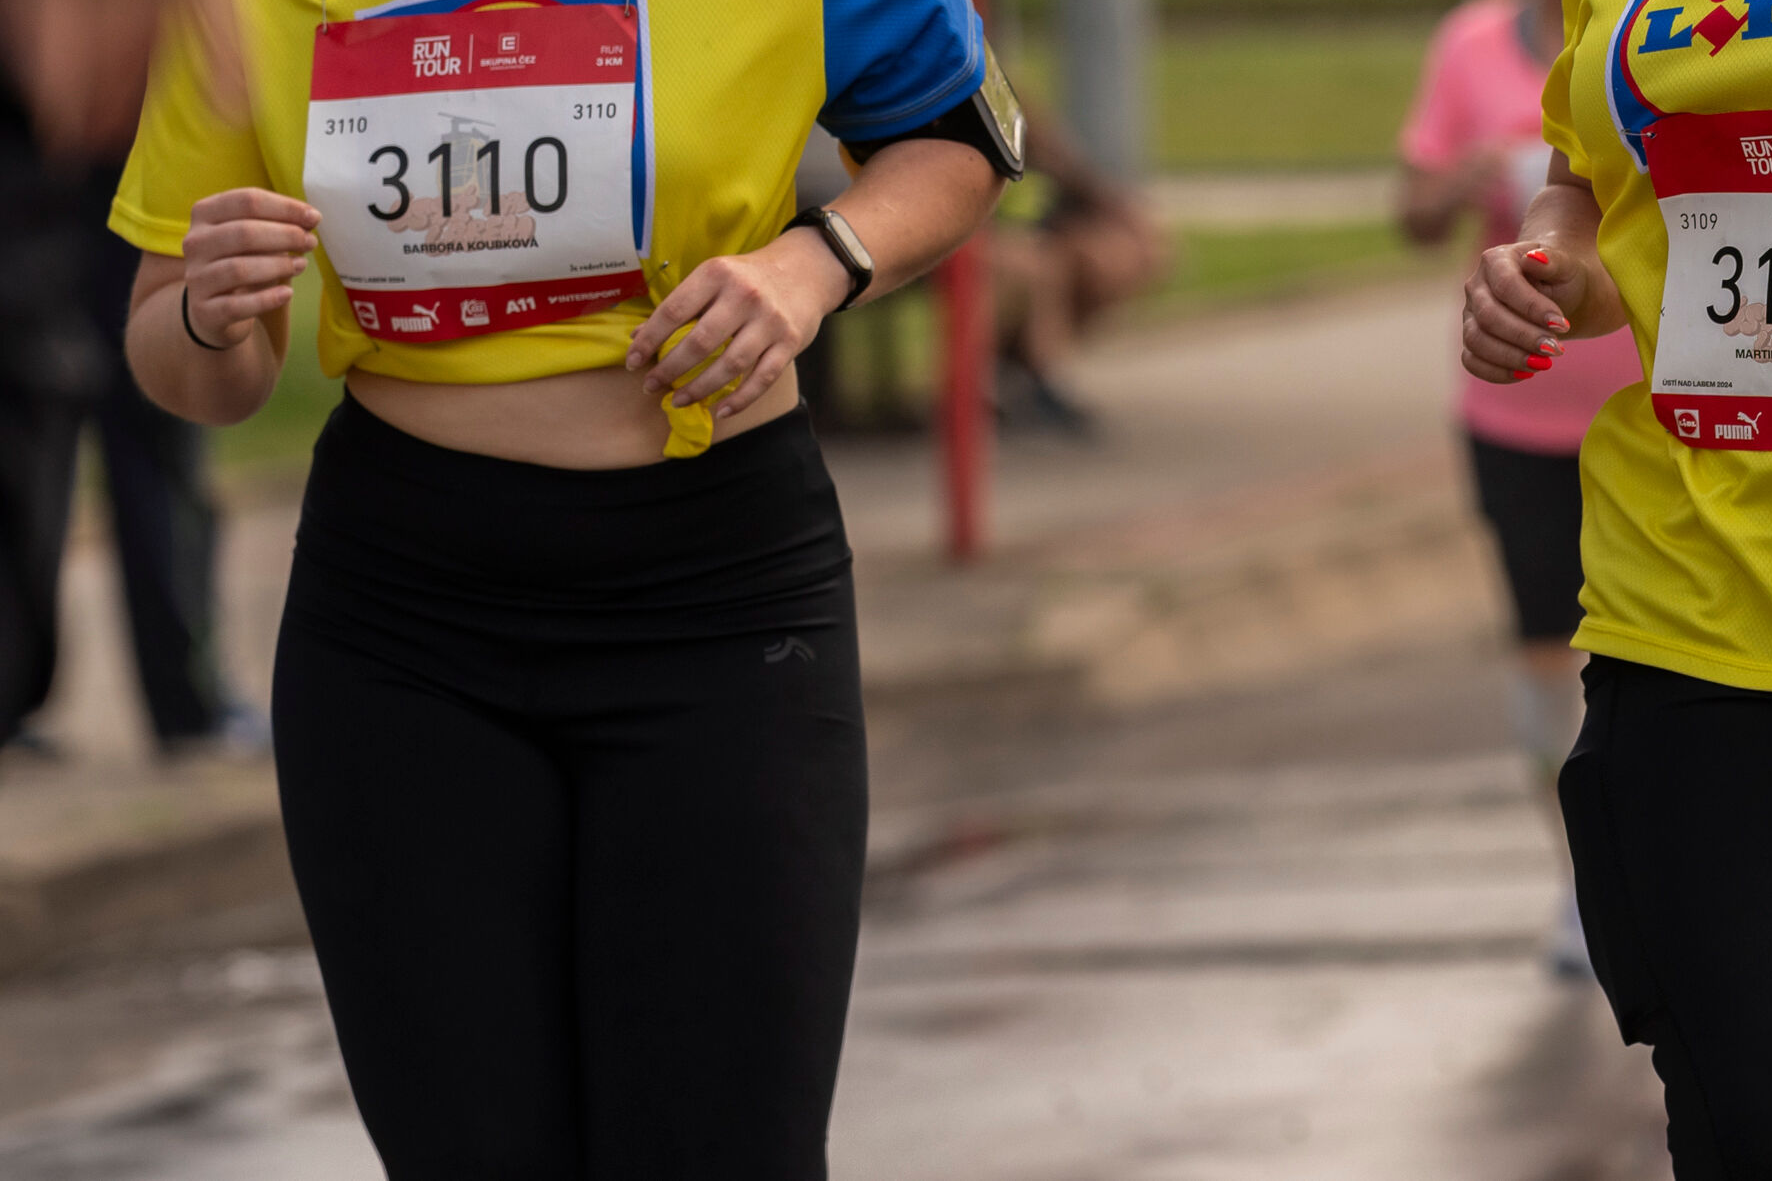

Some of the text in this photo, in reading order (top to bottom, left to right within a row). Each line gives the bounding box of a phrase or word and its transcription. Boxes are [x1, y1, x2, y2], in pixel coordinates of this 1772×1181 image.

[413, 41, 450, 60] RUN
[413, 57, 461, 78] TOUR
[605, 57, 623, 66] KM
[573, 103, 617, 120] 3110
[325, 117, 367, 135] 3110
[367, 137, 568, 221] 3110
[1680, 213, 1718, 231] 3109
[403, 237, 539, 255] BARBORA KOUBKOVÁ
[506, 296, 536, 314] A11
[557, 288, 622, 304] INTERSPORT
[391, 316, 433, 332] PUMA
[1693, 380, 1715, 388] LABEM
[1715, 424, 1753, 440] PUMA
